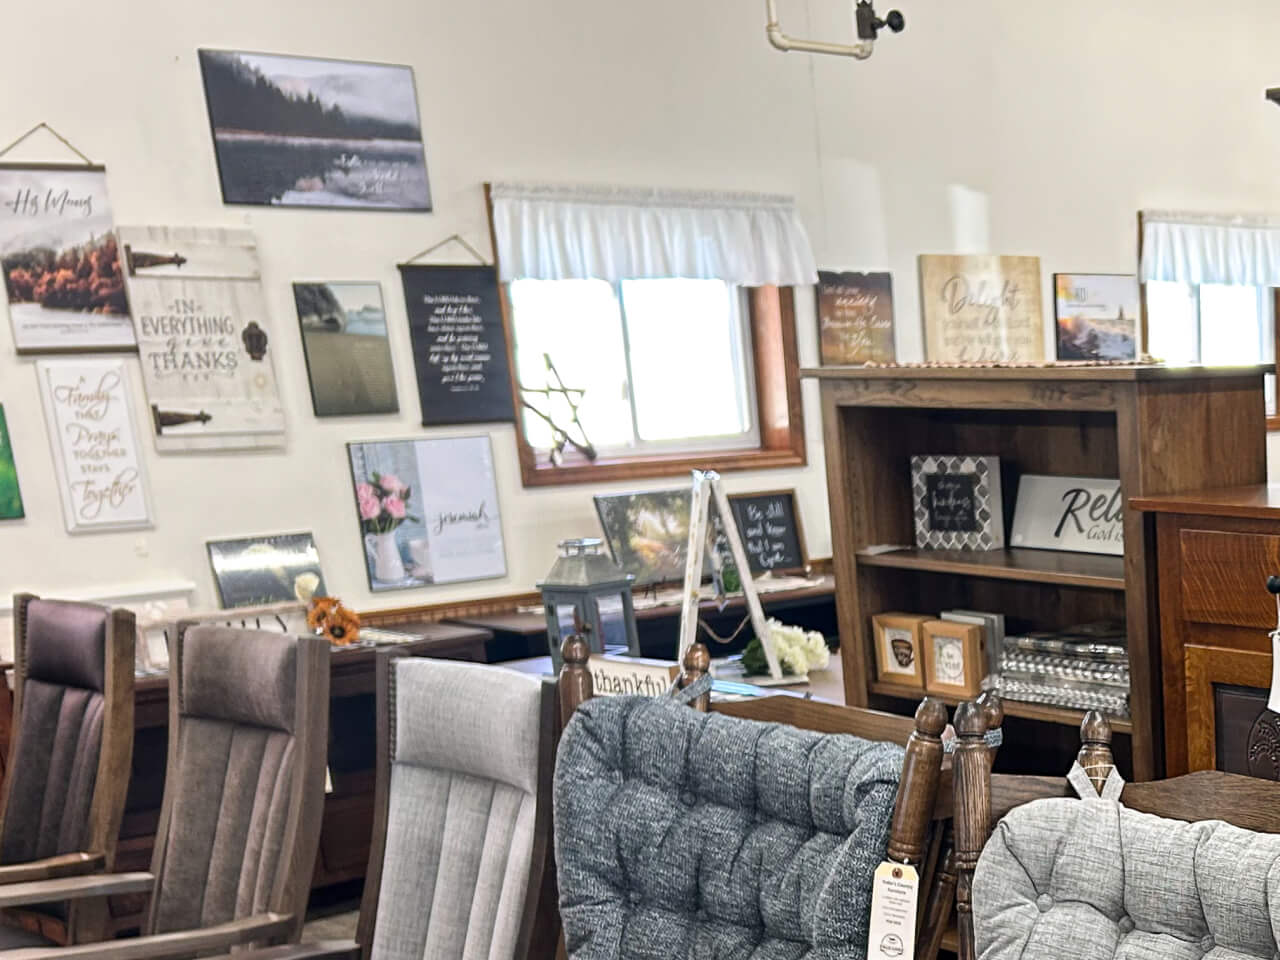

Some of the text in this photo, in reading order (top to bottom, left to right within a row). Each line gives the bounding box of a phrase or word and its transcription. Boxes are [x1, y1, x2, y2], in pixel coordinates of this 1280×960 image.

[141, 315, 234, 336] EVERYTHING
[148, 350, 238, 370] THANKS
[1054, 488, 1123, 538] Rel
[1087, 523, 1116, 541] God
[594, 667, 667, 697] thankful
